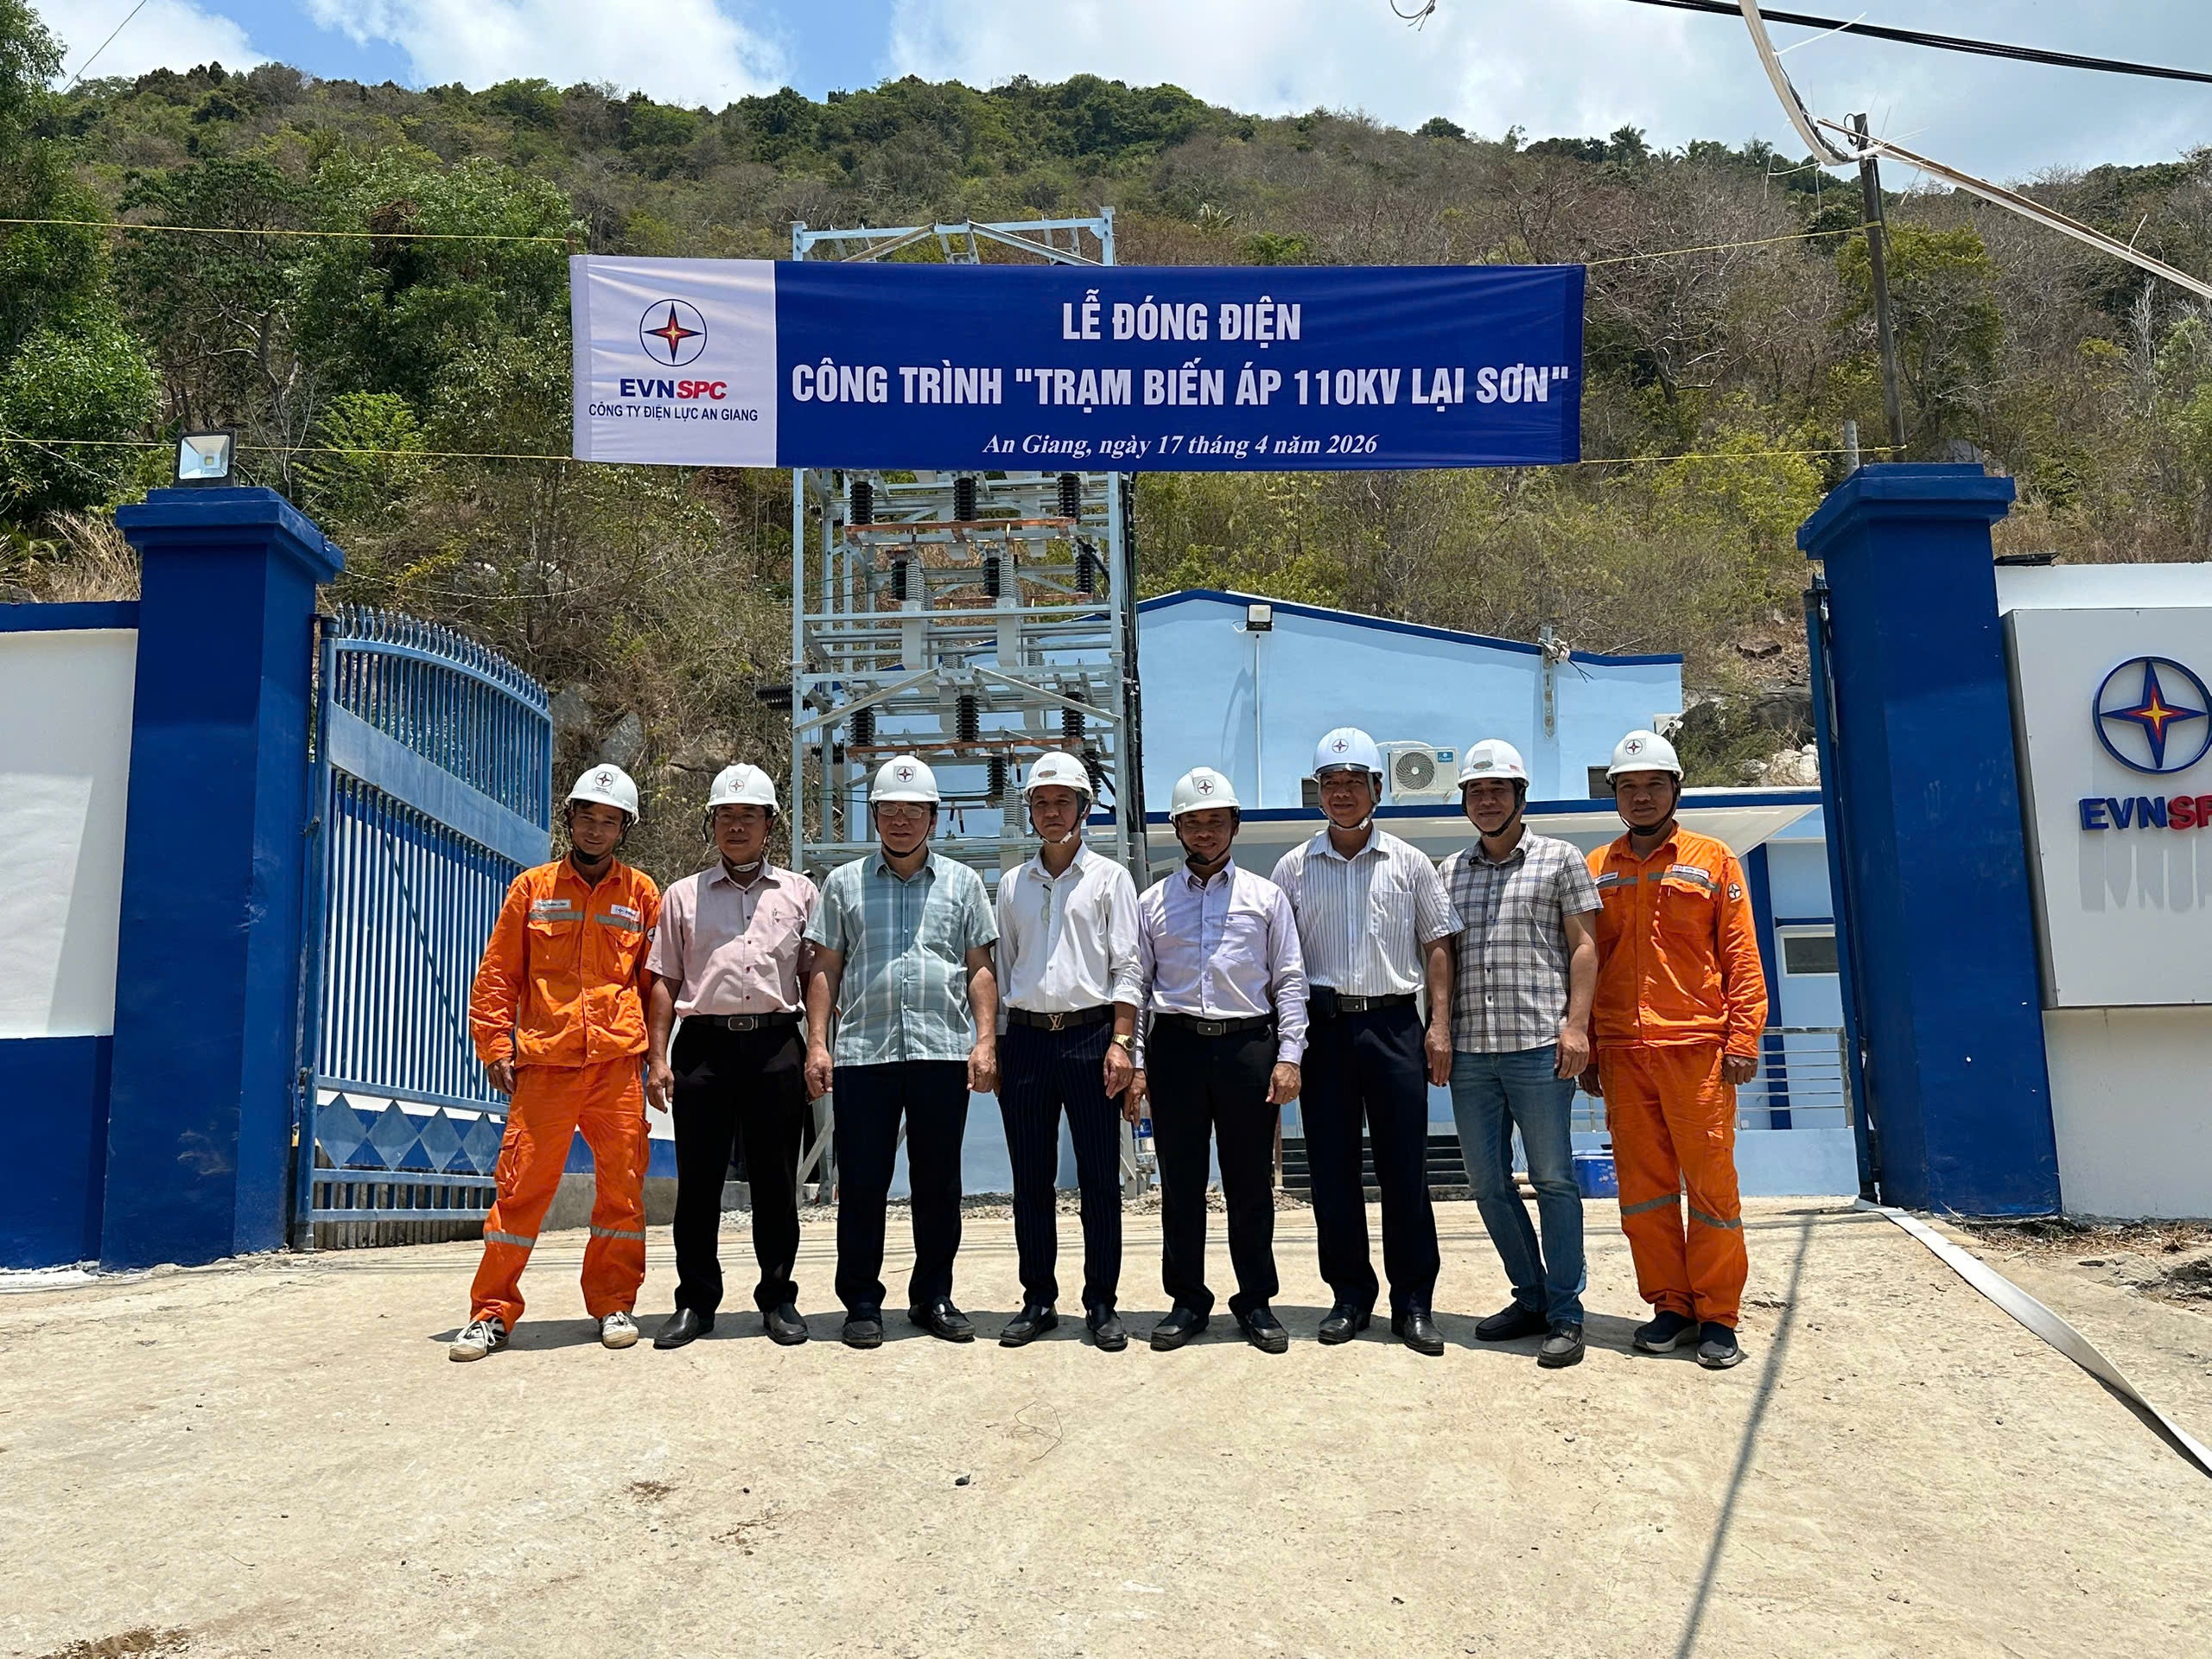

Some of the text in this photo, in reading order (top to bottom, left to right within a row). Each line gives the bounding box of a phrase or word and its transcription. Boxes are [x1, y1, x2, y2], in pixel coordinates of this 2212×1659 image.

[1062, 289, 1300, 349] LỄ ĐÓNG ĐIỆN
[620, 378, 728, 400] EVNSPC
[791, 357, 1568, 414] CÔNG TRÌNH "TRẠM BIẾN ÁP 110KV LẠI SƠN"
[588, 401, 758, 422] CÔNG TY ĐIỆN LỰC AN GIANG
[982, 434, 1380, 458] An Giang, ngày 17 tháng 4 năm 2026
